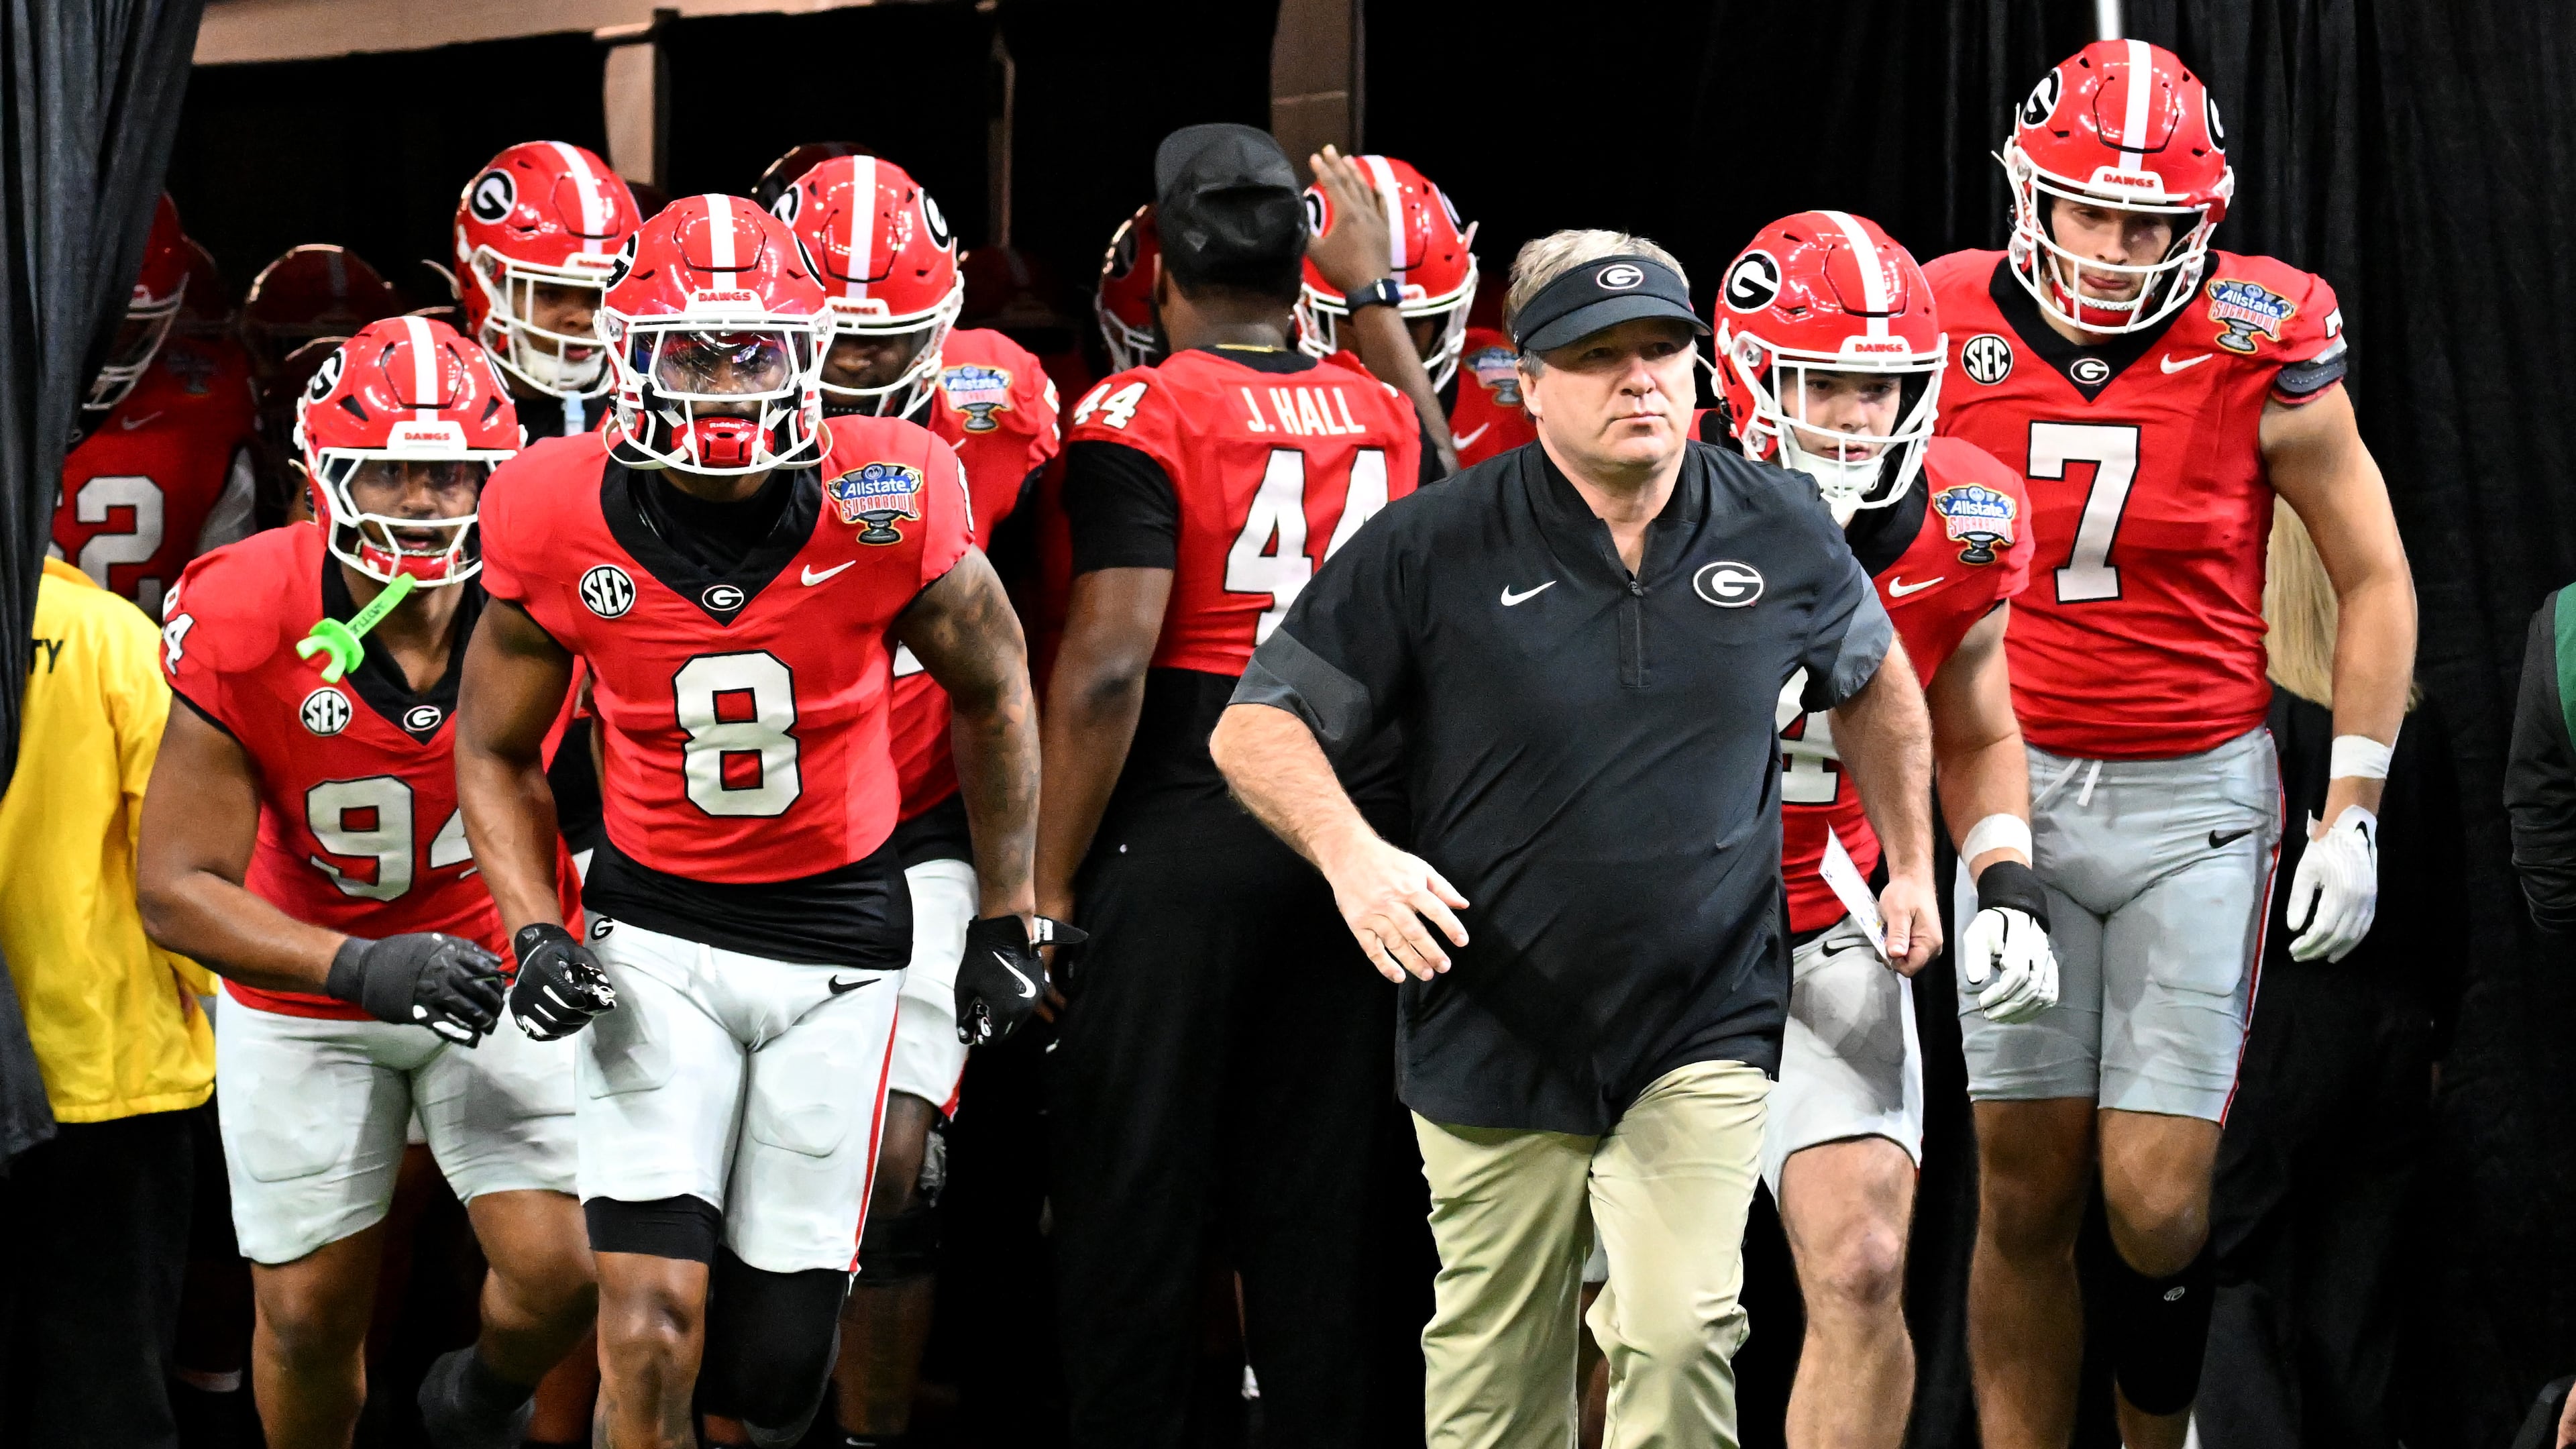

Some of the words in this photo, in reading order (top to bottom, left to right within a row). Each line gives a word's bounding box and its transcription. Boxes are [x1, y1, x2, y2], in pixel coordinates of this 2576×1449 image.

[2103, 173, 2155, 189] DAWGS
[473, 172, 515, 219] G
[1600, 266, 1644, 288] G
[1727, 255, 1780, 308] G
[698, 291, 752, 302] DAWGS
[2219, 289, 2275, 315] Allstate
[1854, 343, 1904, 353] DAWGS
[1964, 336, 2010, 383] SEC
[2074, 360, 2109, 382] G
[1074, 381, 1148, 429] 44
[404, 432, 451, 441] DAWGS
[844, 478, 908, 497] Allstate
[1949, 499, 2005, 518] Allstate
[2027, 419, 2141, 605] 7
[46, 474, 165, 623] 2
[582, 567, 633, 616] SEC
[1699, 564, 1764, 604] G
[706, 586, 743, 608] G
[301, 688, 350, 735] SEC
[407, 706, 441, 731] G
[671, 648, 802, 818] 8
[591, 918, 614, 940] G
